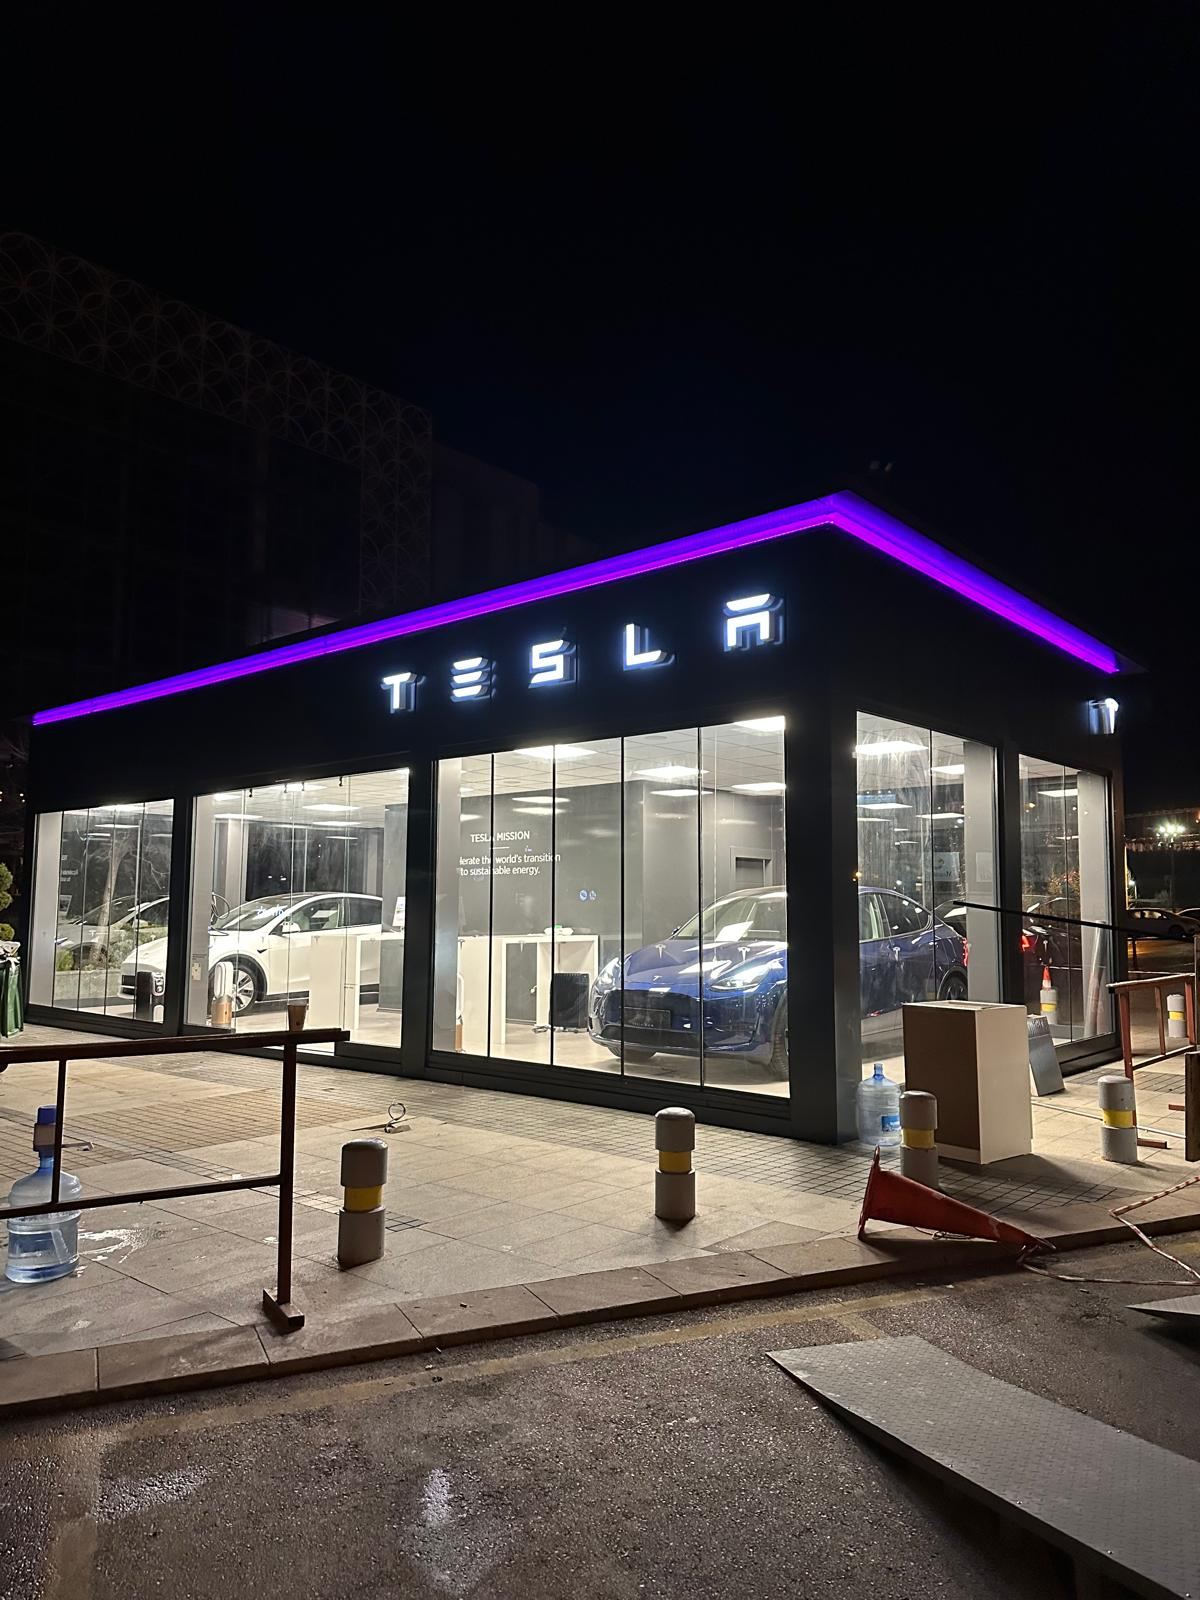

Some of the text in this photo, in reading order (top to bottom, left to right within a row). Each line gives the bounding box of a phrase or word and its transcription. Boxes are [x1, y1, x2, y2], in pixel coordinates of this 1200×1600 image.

[381, 593, 782, 712] TESLA
[496, 831, 530, 841] MISSION
[481, 855, 493, 865] th
[495, 853, 522, 864] world's
[460, 867, 469, 876] to
[512, 866, 540, 876] energy.
